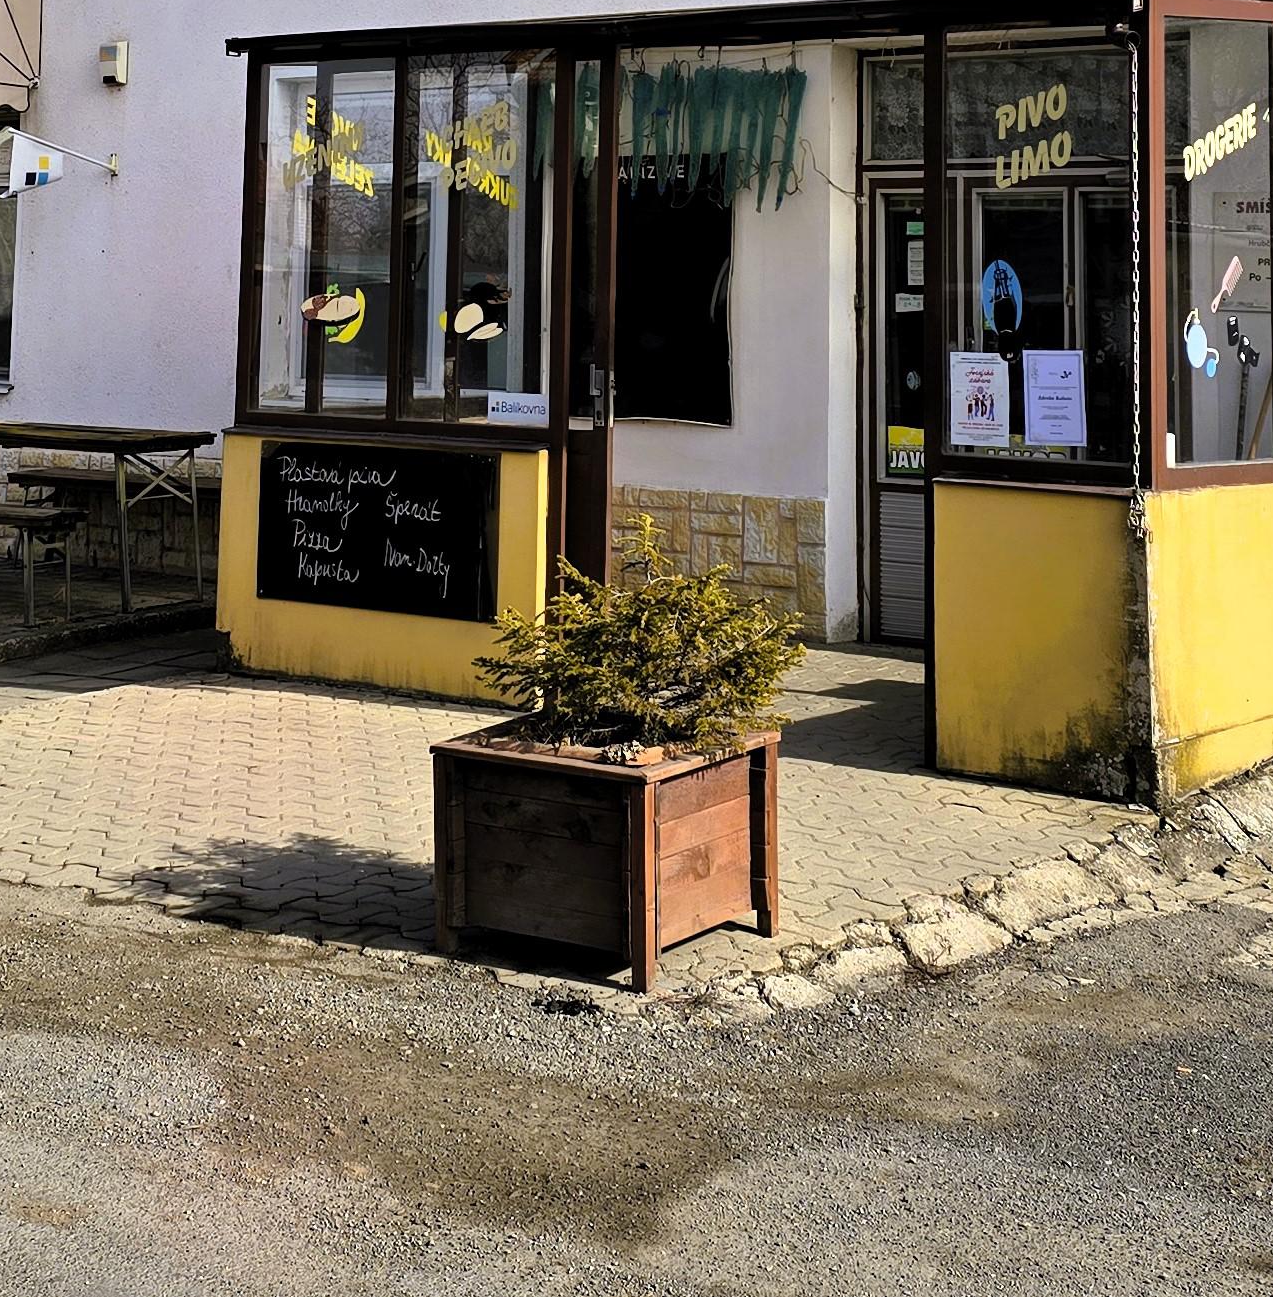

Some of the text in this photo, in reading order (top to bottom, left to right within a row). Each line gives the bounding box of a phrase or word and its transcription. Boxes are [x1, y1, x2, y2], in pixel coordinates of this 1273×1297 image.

[995, 83, 1068, 140] PIVO
[995, 130, 1072, 190] LIMO
[1182, 102, 1257, 182] DROGERIE
[298, 552, 360, 585] Kapusta
